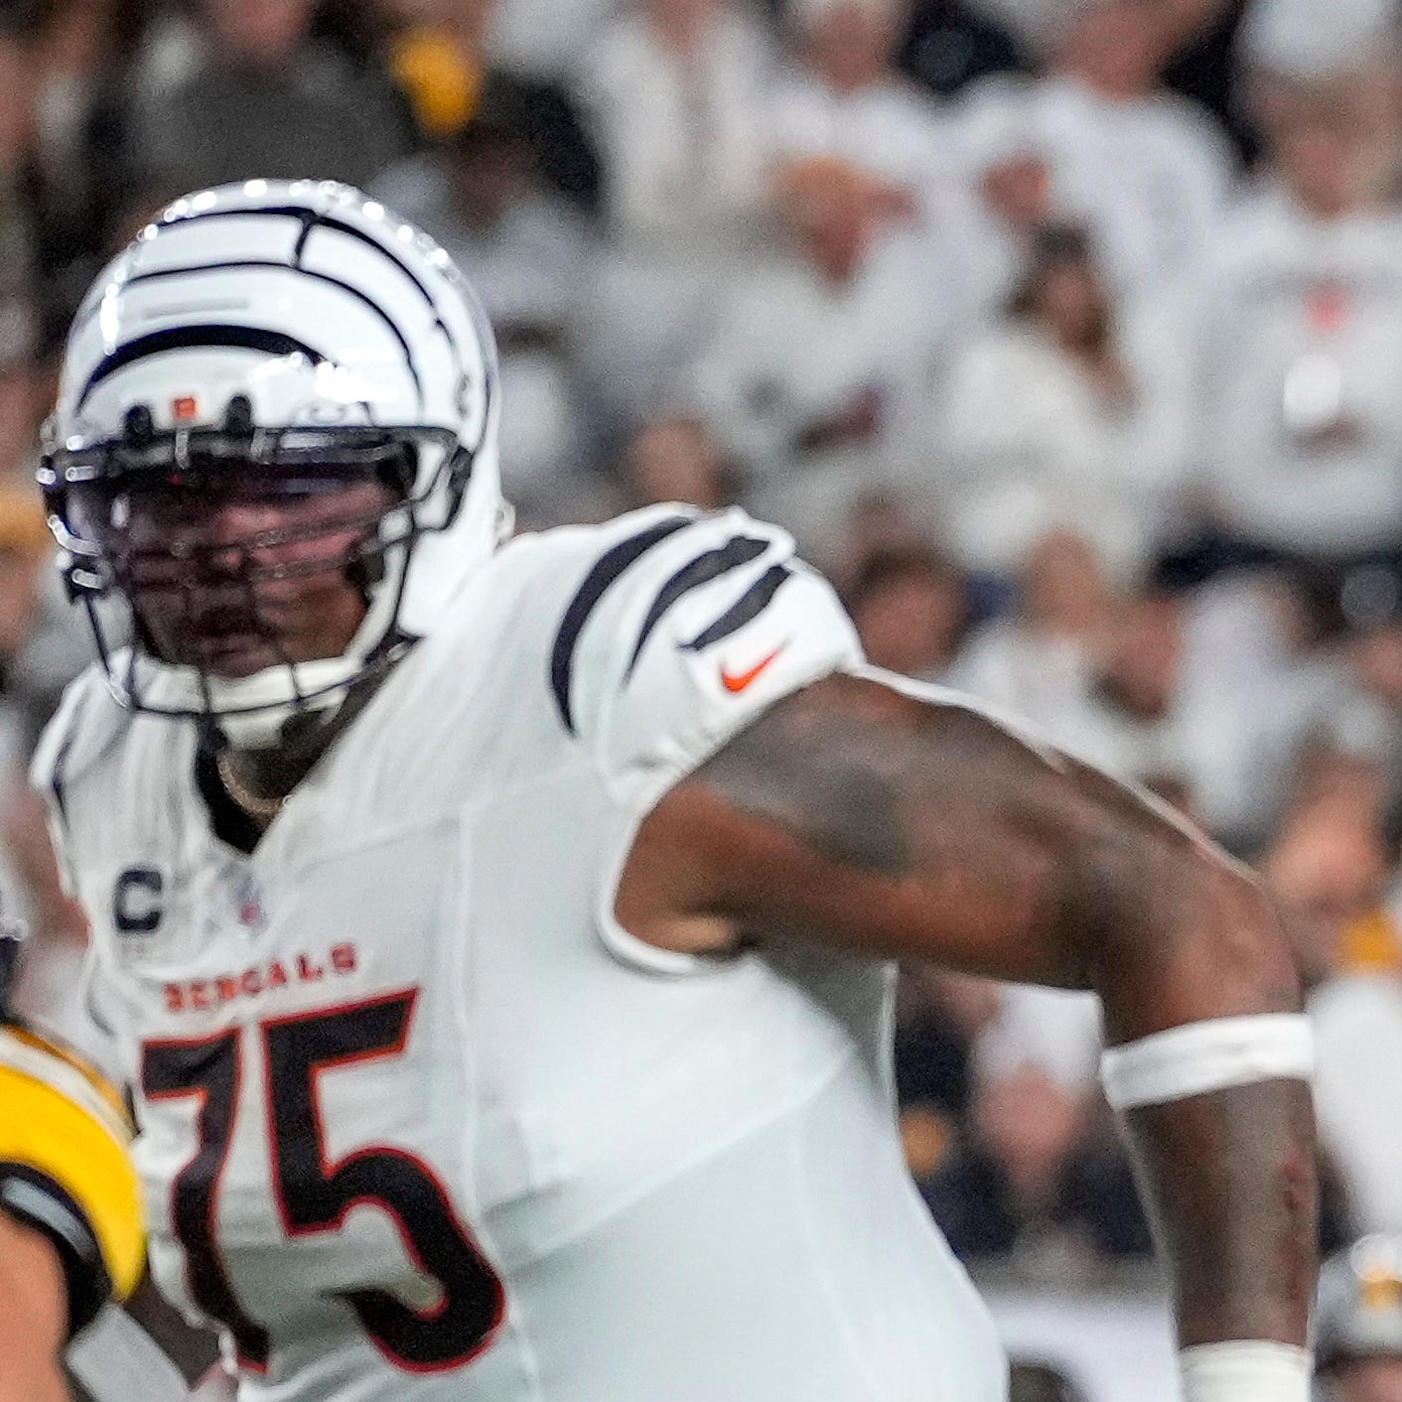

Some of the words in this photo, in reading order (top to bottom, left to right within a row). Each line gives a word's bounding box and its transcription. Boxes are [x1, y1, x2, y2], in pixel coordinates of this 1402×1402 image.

[113, 867, 164, 933] C
[163, 942, 358, 1012] BENGALS
[140, 984, 506, 1375] 75
